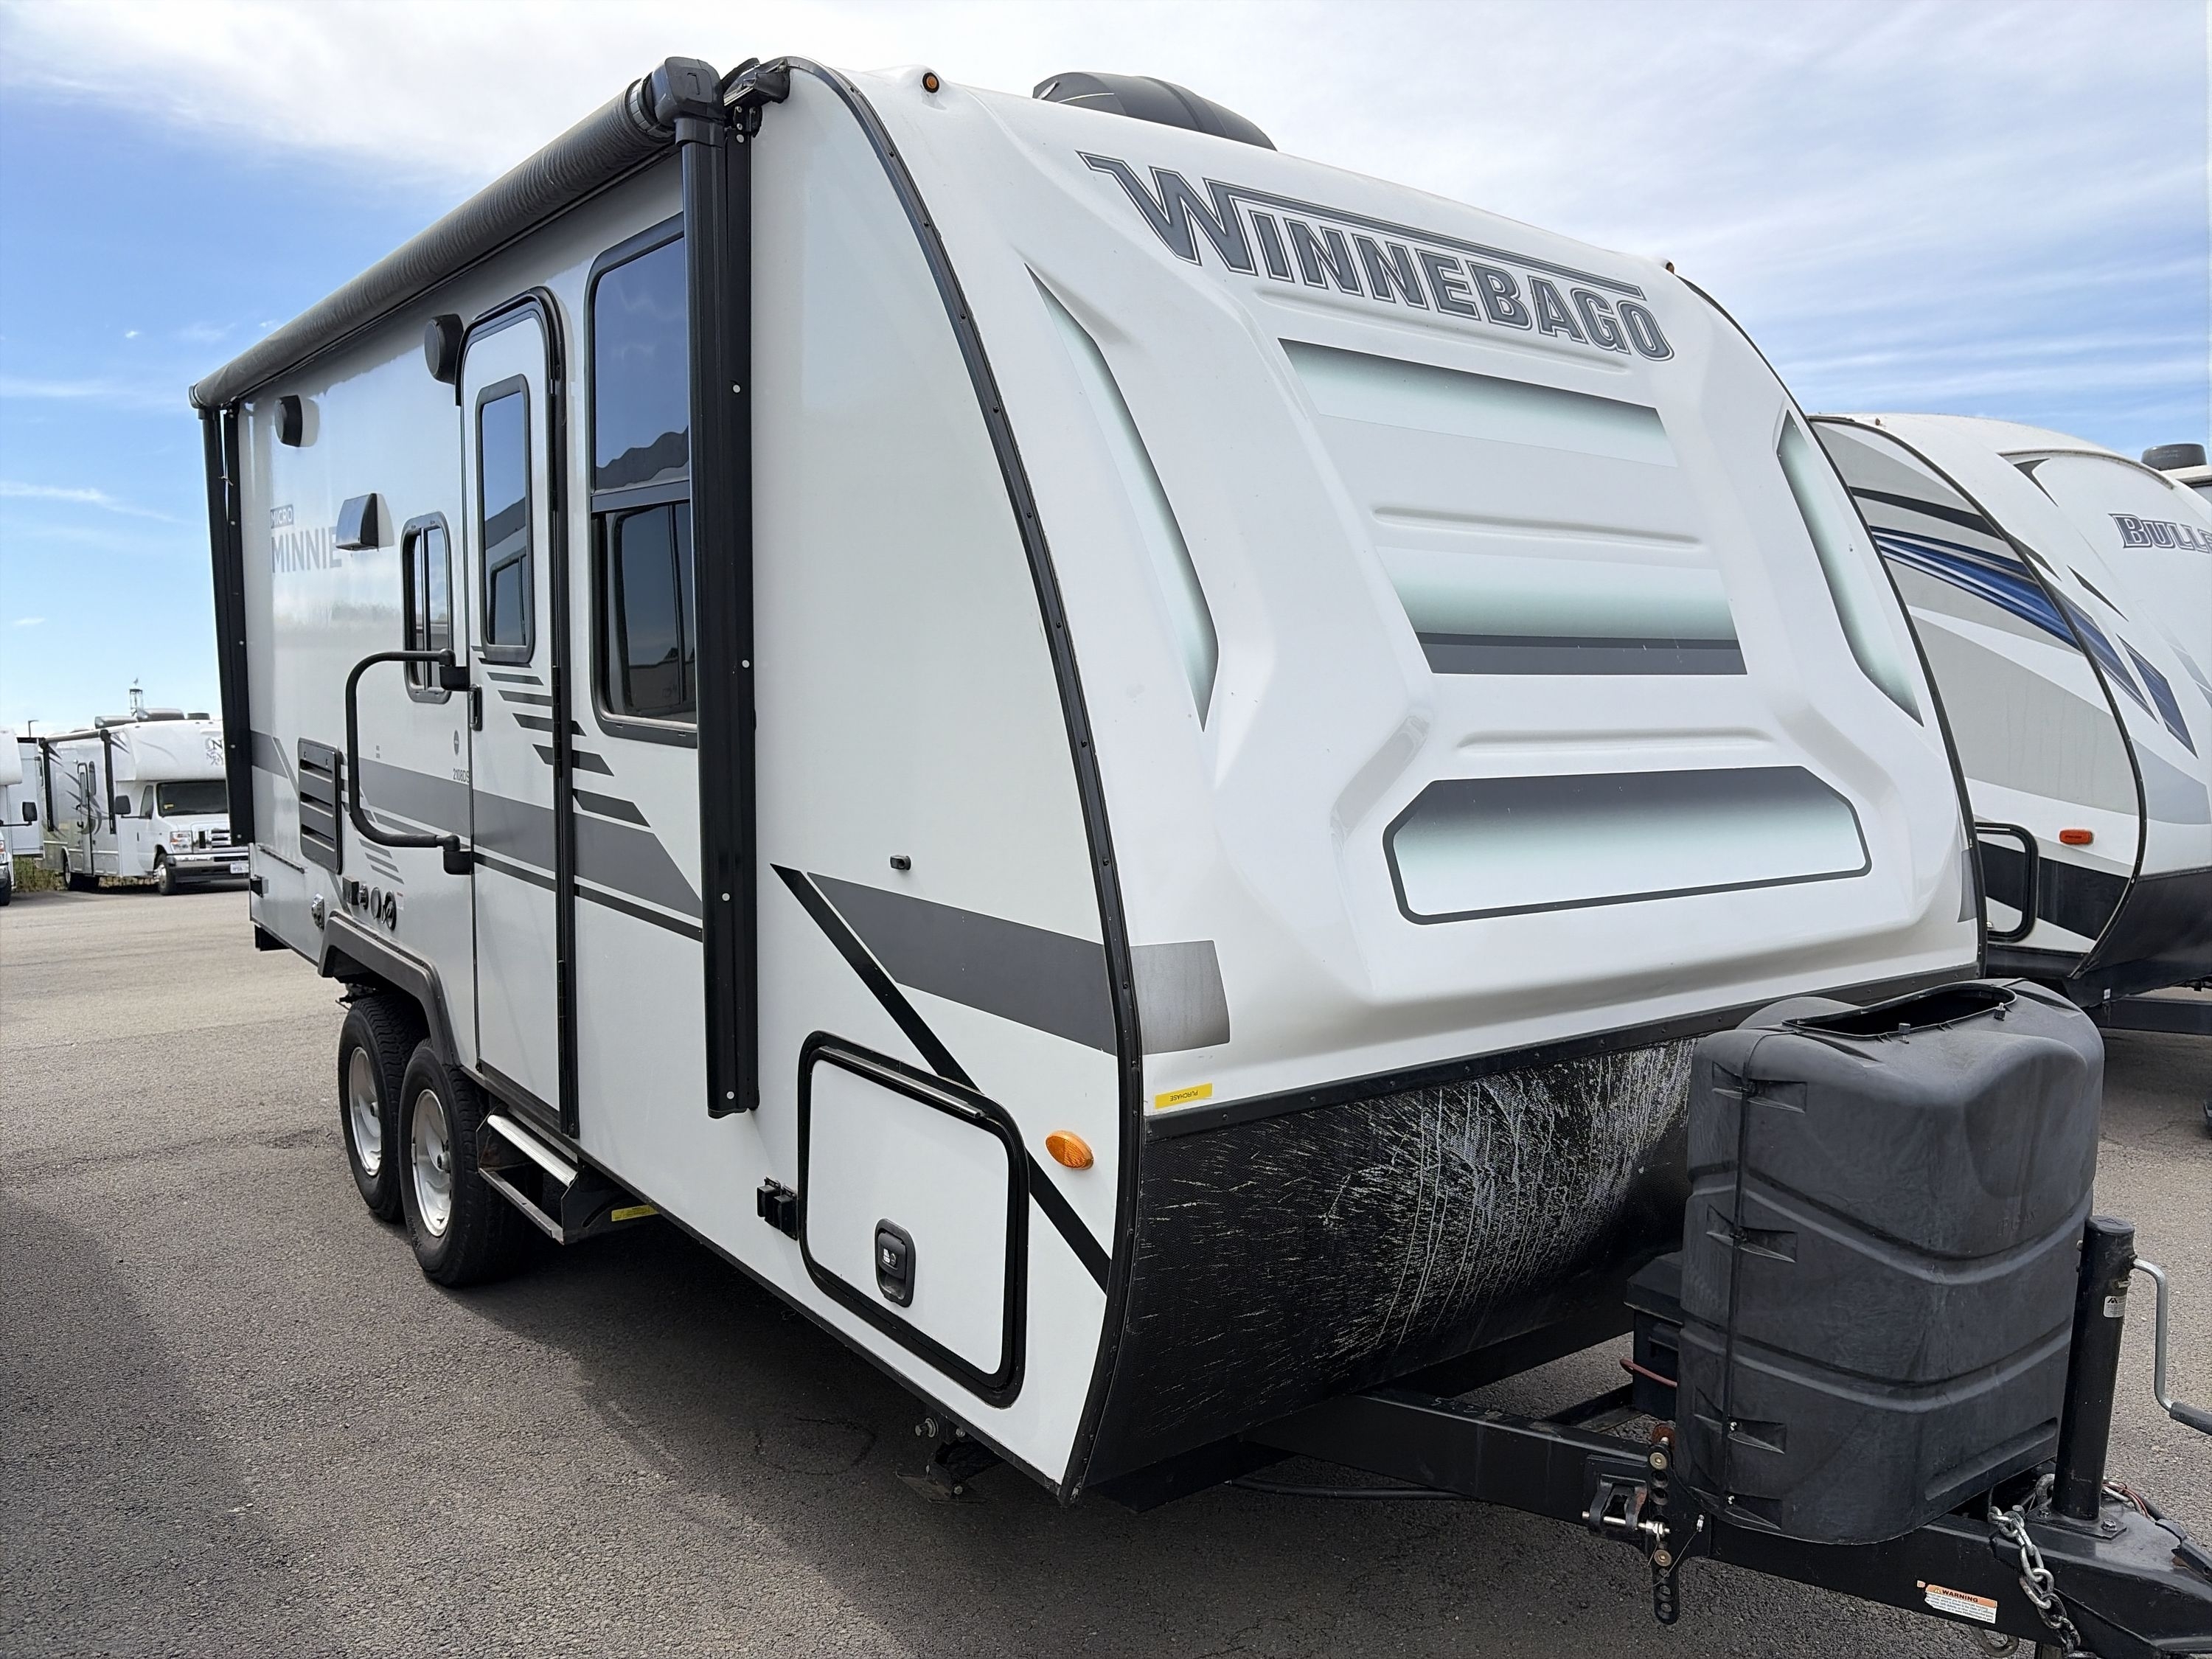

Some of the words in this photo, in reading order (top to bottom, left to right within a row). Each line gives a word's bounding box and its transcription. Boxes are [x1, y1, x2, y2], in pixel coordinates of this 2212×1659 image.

[1075, 150, 1675, 361] WINNEBAGO
[271, 507, 293, 526] MICRO
[271, 526, 342, 573] MINNIE
[1169, 1090, 1199, 1102] PURCHASE
[1942, 1588, 1978, 1603] WARNING
